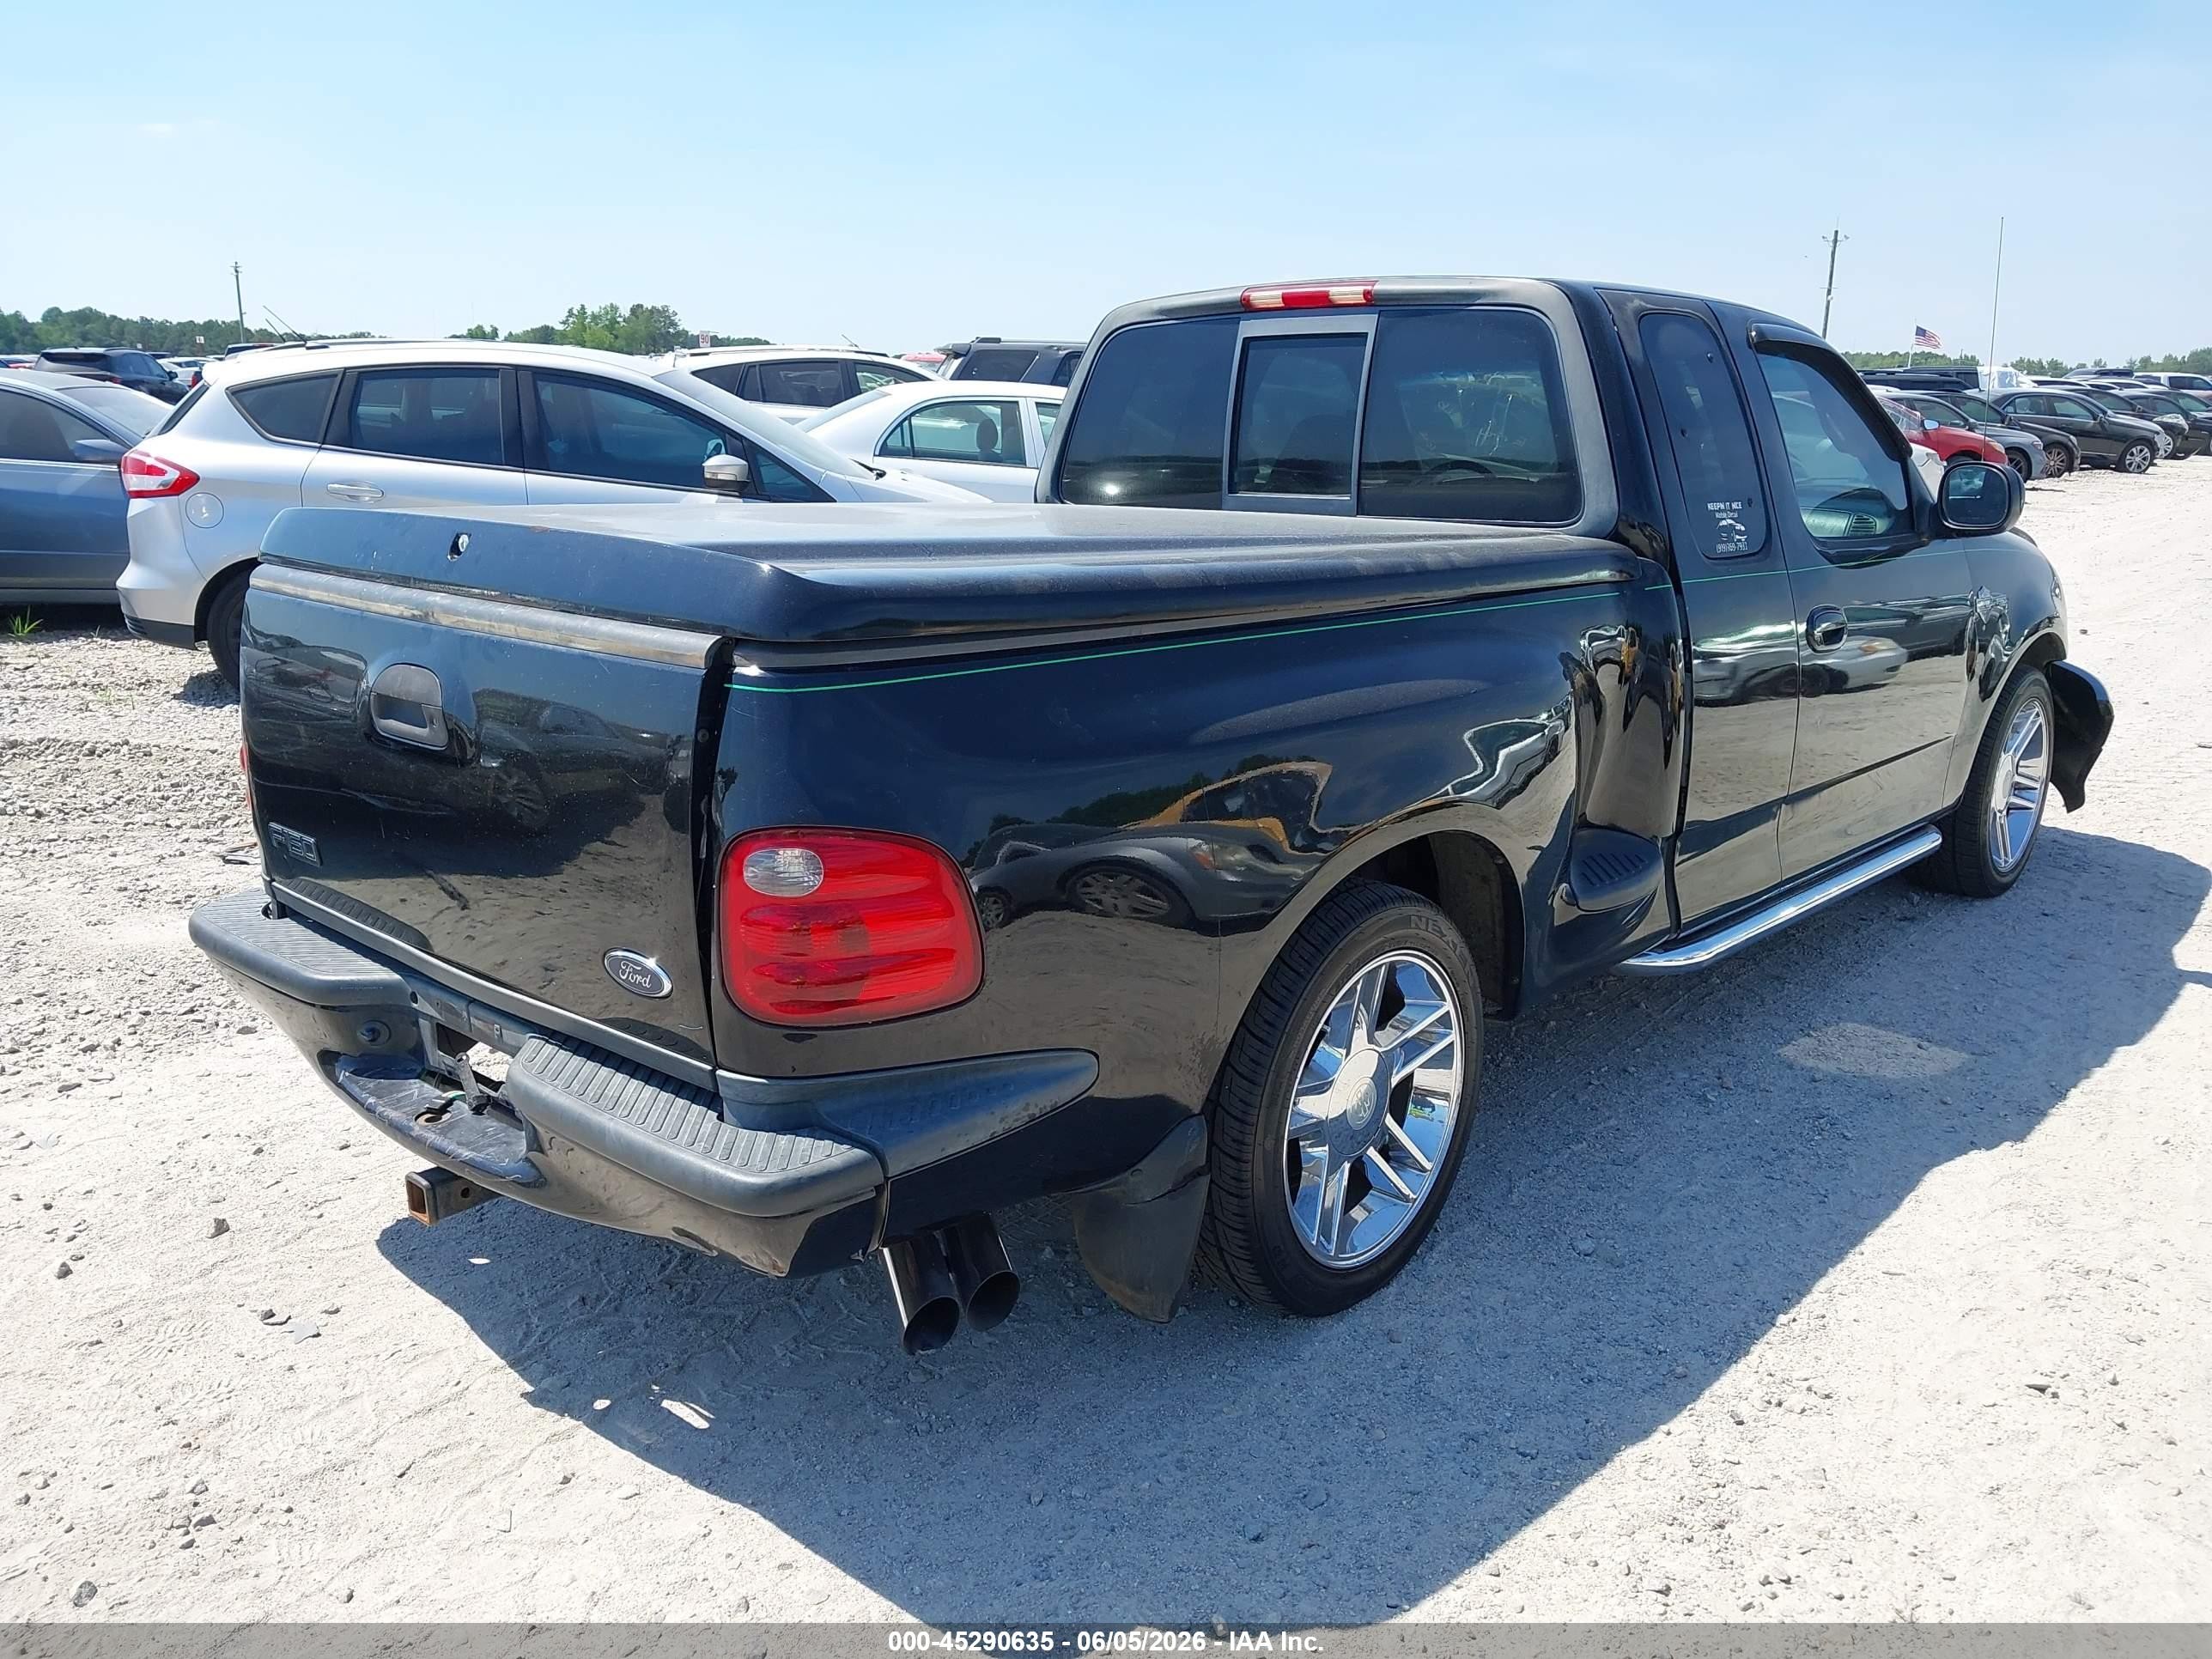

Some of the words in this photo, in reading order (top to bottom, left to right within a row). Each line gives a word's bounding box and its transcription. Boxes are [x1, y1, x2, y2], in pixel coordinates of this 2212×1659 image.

[700, 333, 709, 344] 90
[1725, 501, 1730, 510] IT
[1731, 501, 1742, 510] NICE
[618, 960, 653, 988] Ford
